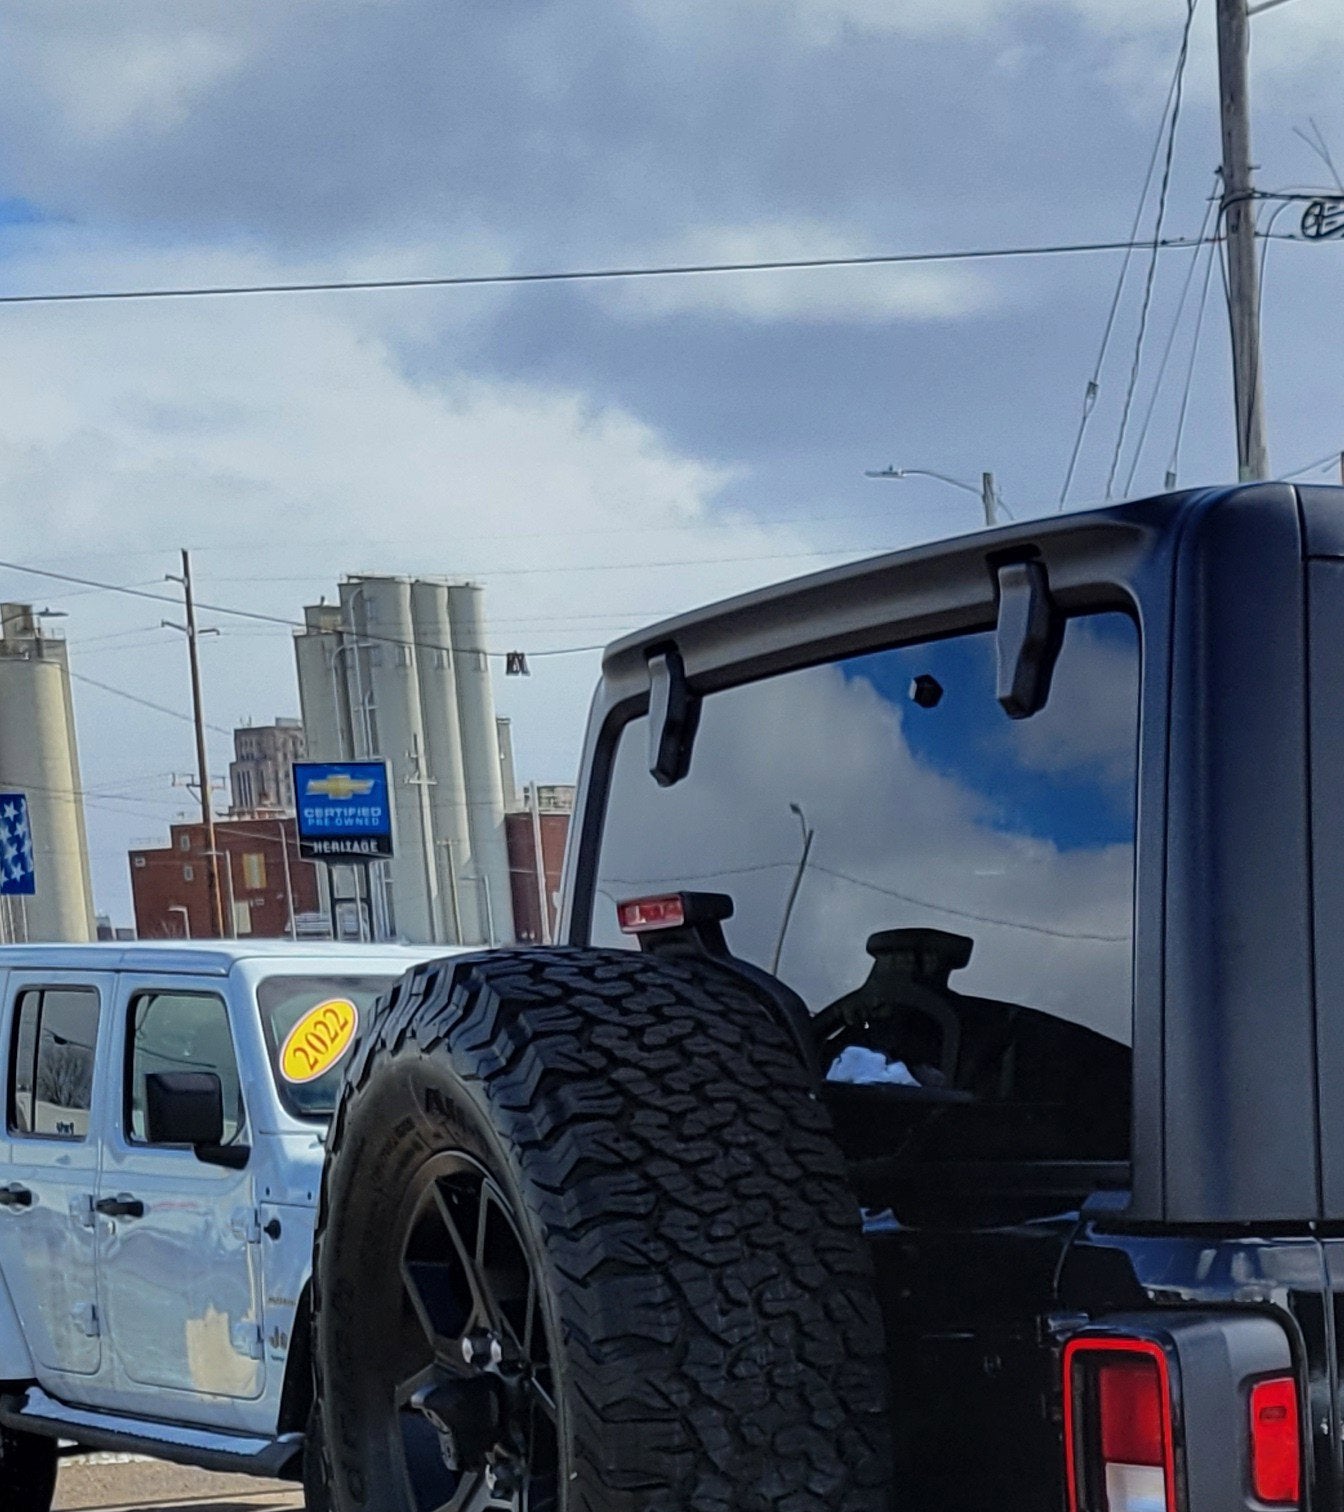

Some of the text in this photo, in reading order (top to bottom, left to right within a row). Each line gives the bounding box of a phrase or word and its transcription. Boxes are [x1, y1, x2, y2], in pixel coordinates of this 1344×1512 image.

[304, 807, 382, 818] CERTIFIED
[313, 840, 379, 853] HERITAGE
[293, 1008, 349, 1072] 2022
